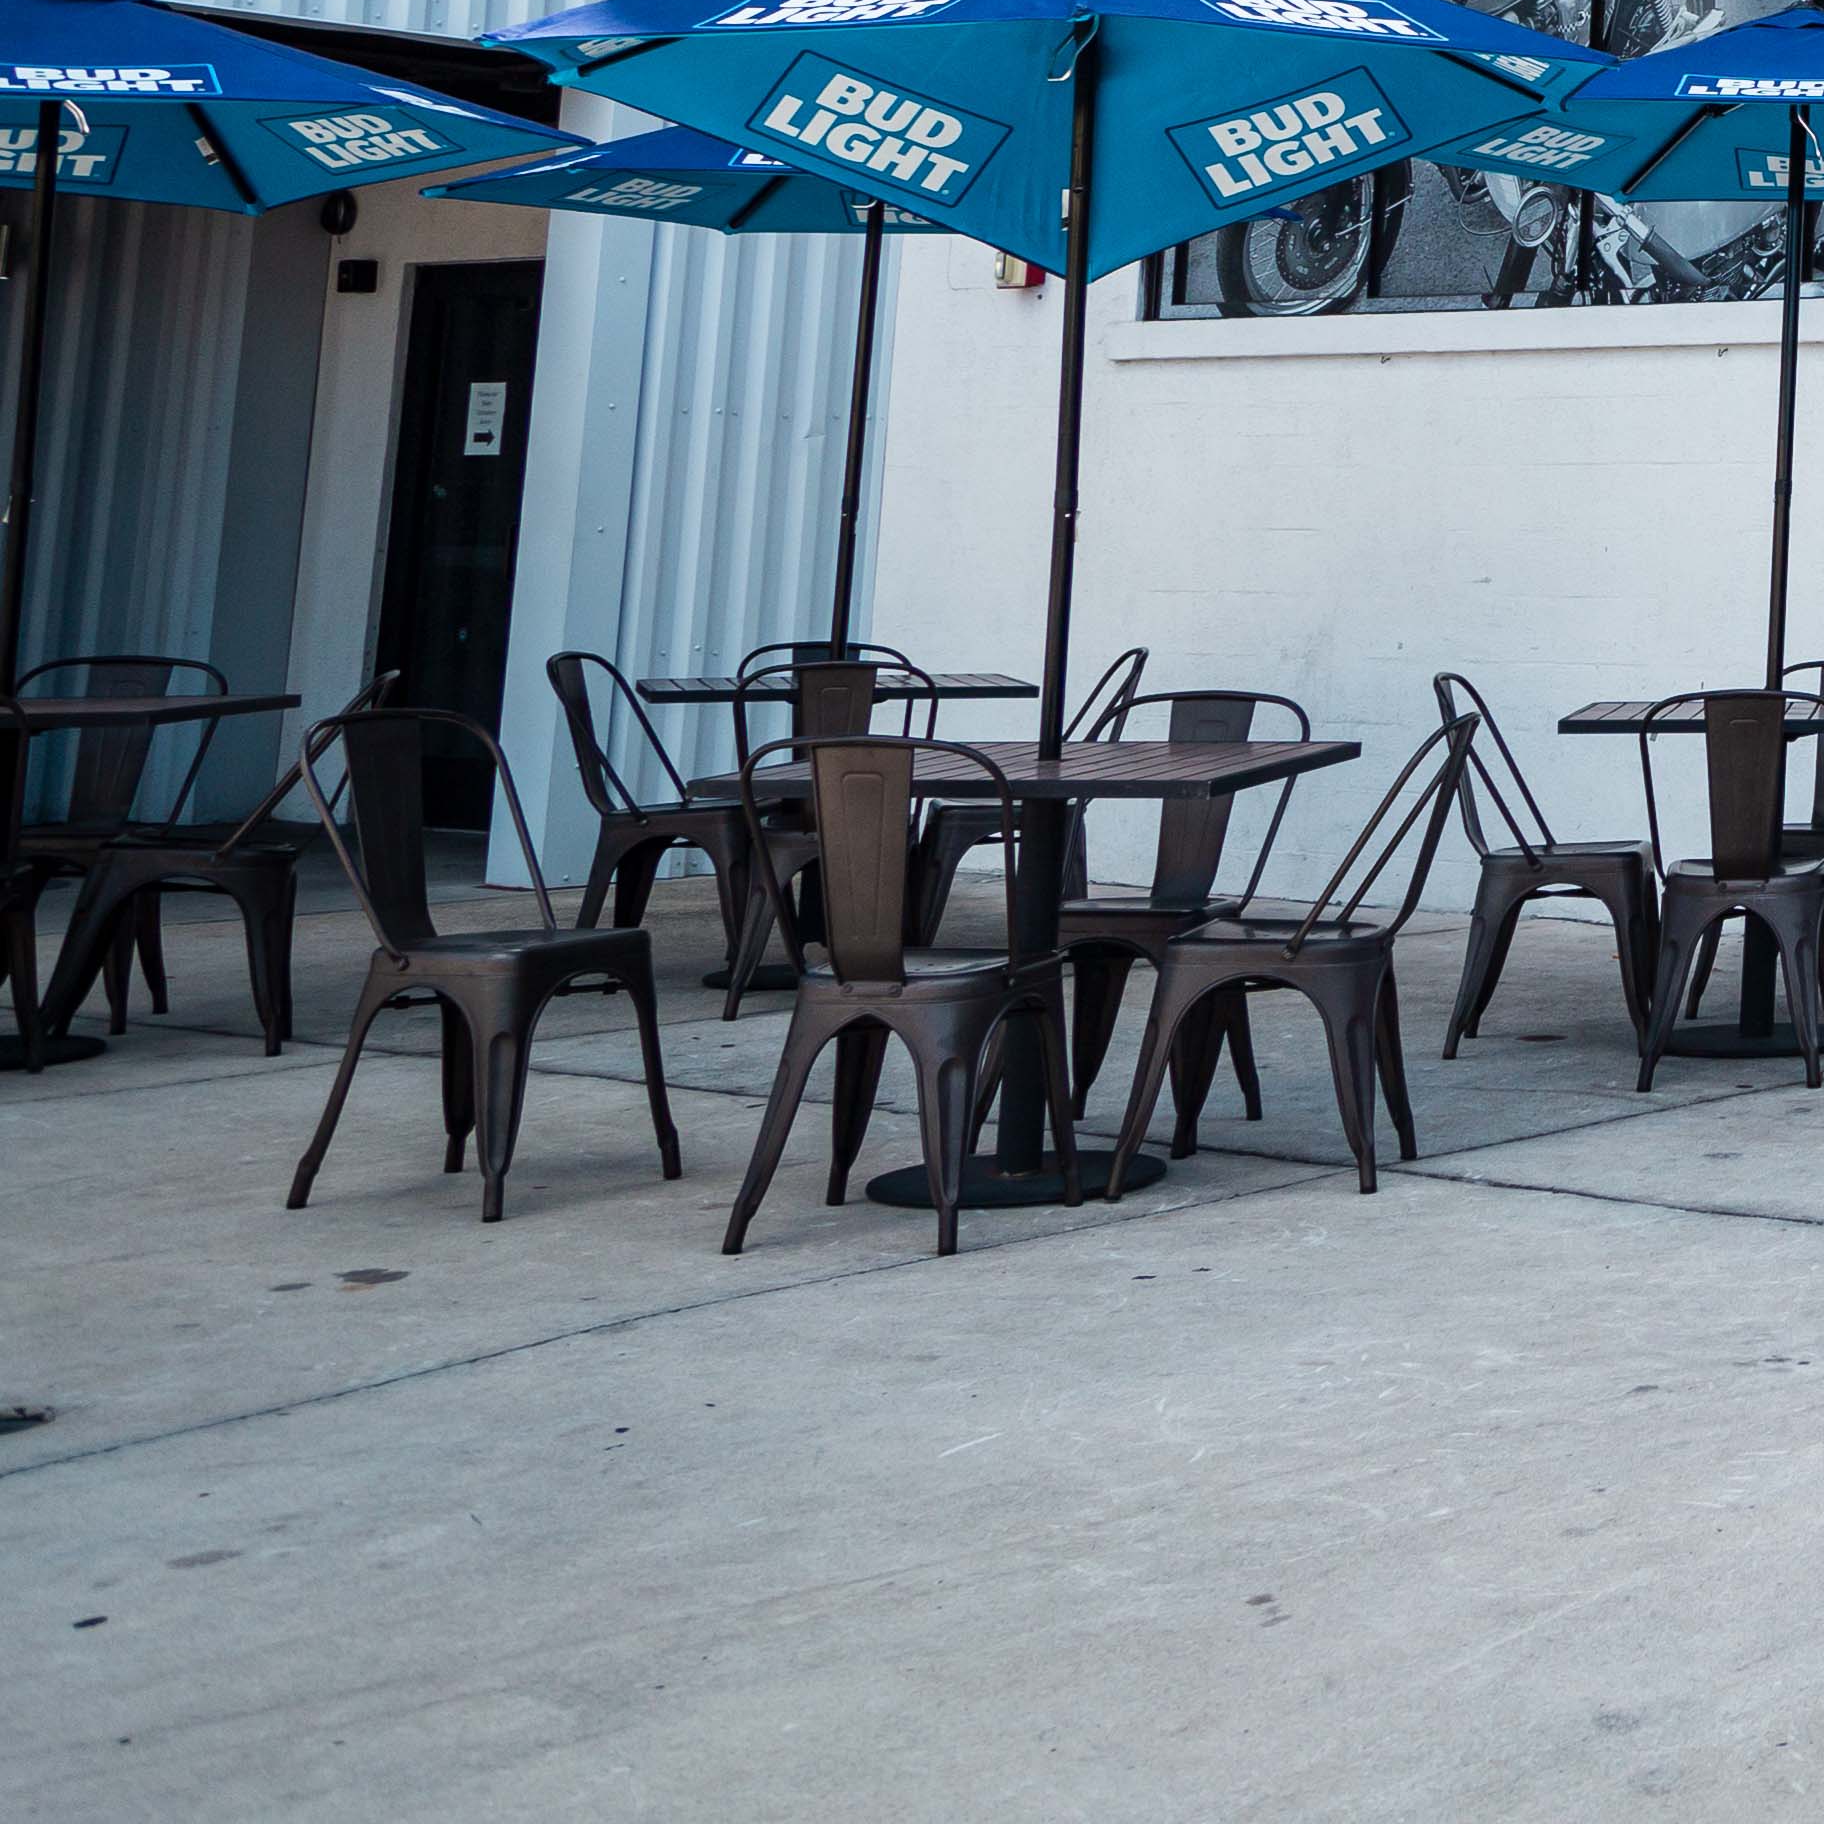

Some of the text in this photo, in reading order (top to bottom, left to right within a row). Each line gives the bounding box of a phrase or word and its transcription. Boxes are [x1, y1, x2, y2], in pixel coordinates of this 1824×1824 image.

[716, 0, 947, 24] LIGHT
[1217, 3, 1417, 36] LIGHT
[0, 77, 204, 92] LIGHT
[14, 67, 171, 81] BUD
[816, 74, 964, 148] BUD
[1208, 92, 1346, 157] BUD
[0, 129, 85, 154] UD
[289, 113, 393, 144] BUD
[763, 95, 969, 192] LIGHT
[1519, 126, 1605, 154] BUD
[305, 129, 442, 169] LIGHT
[1205, 108, 1389, 197] LIGHT
[1473, 137, 1595, 168] LIGHT
[571, 188, 697, 211] LIGHT
[612, 178, 703, 199] BUD
